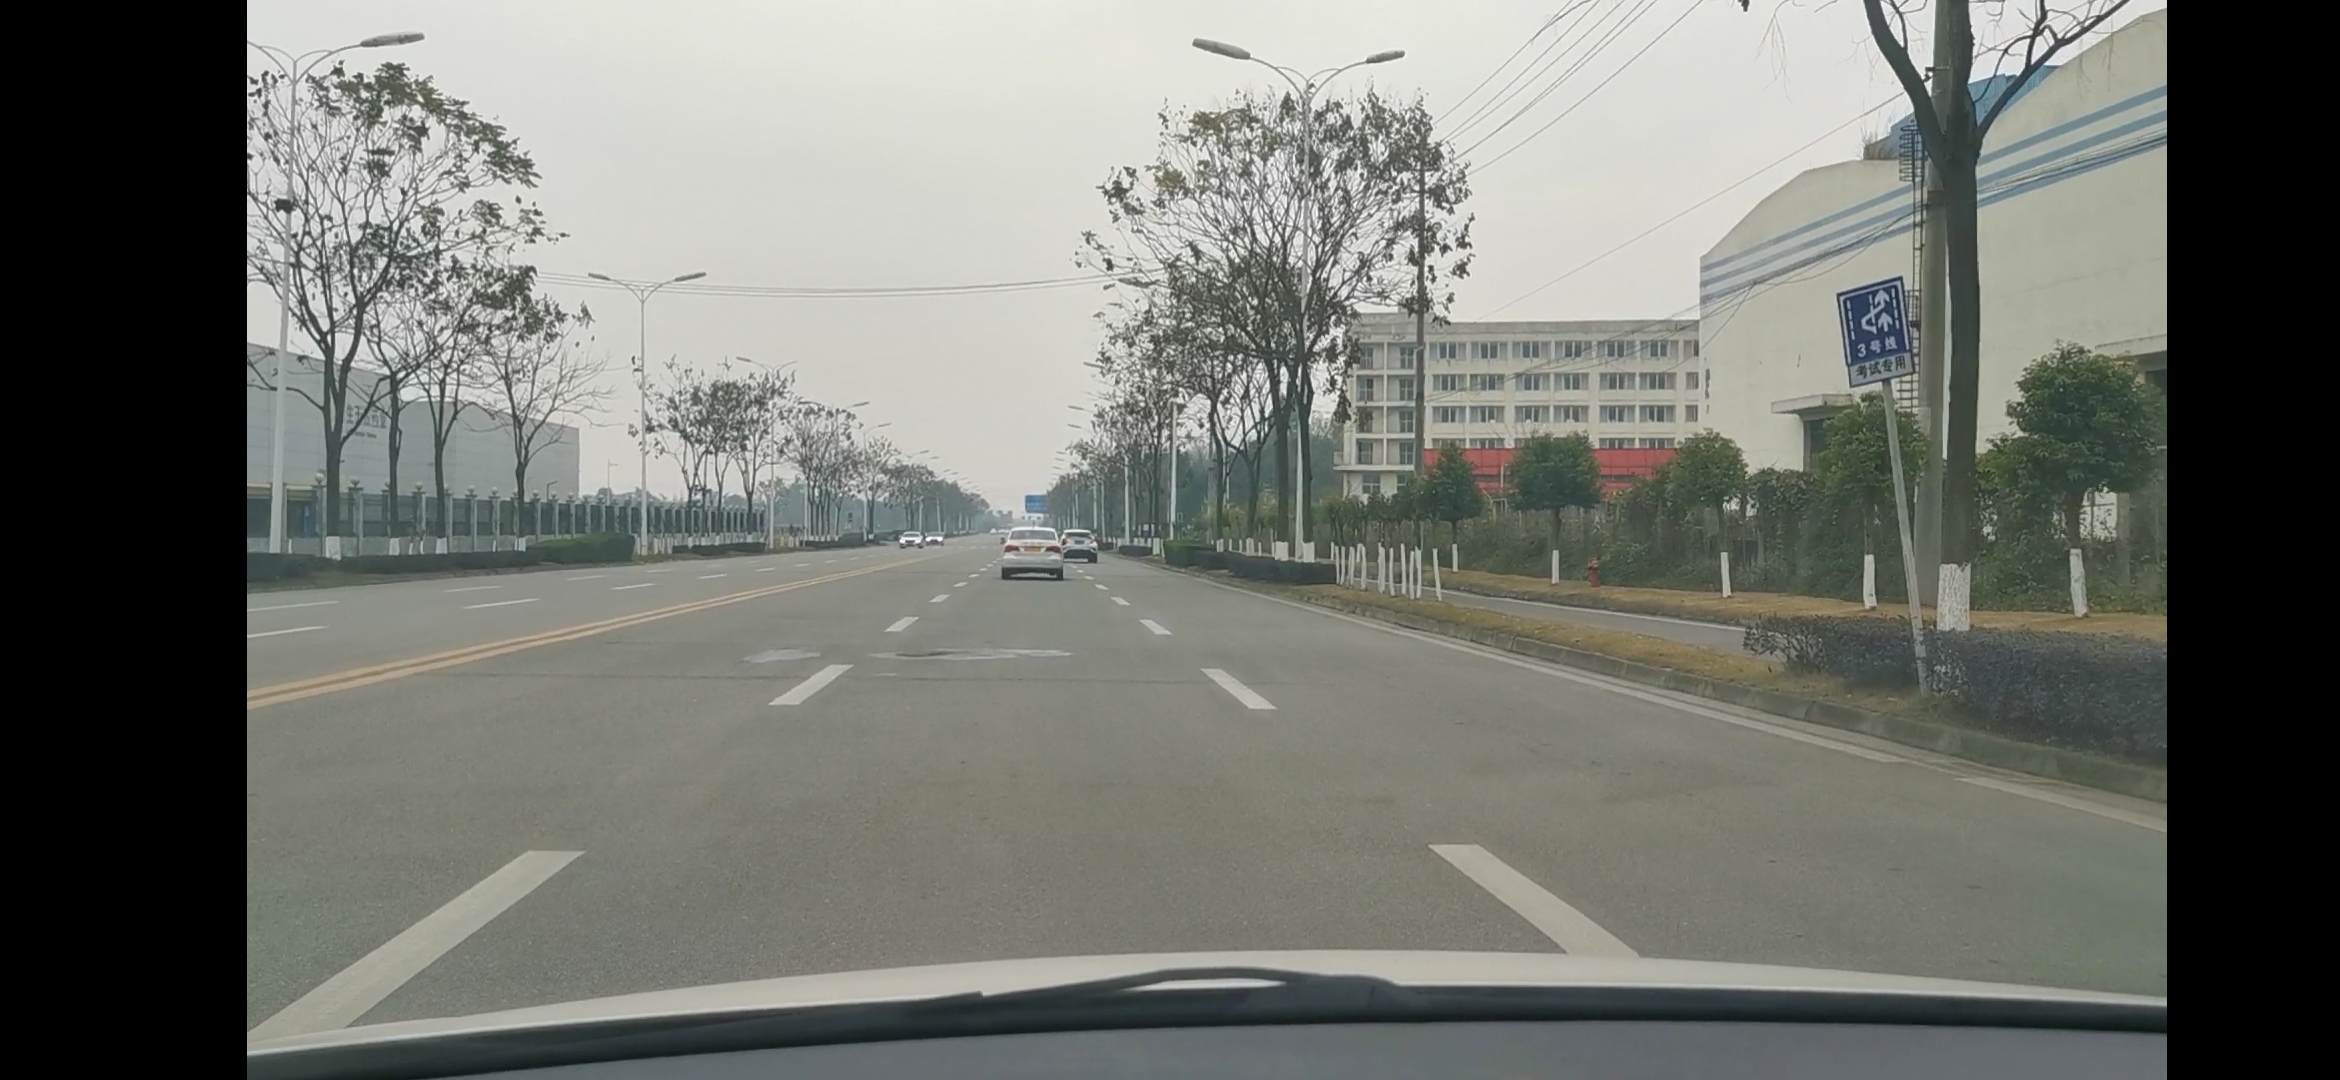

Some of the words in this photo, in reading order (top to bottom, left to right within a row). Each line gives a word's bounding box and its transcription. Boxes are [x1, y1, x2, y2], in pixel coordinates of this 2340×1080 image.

[1857, 335, 1898, 358] 3号线
[1856, 355, 1906, 379] 考试专用
